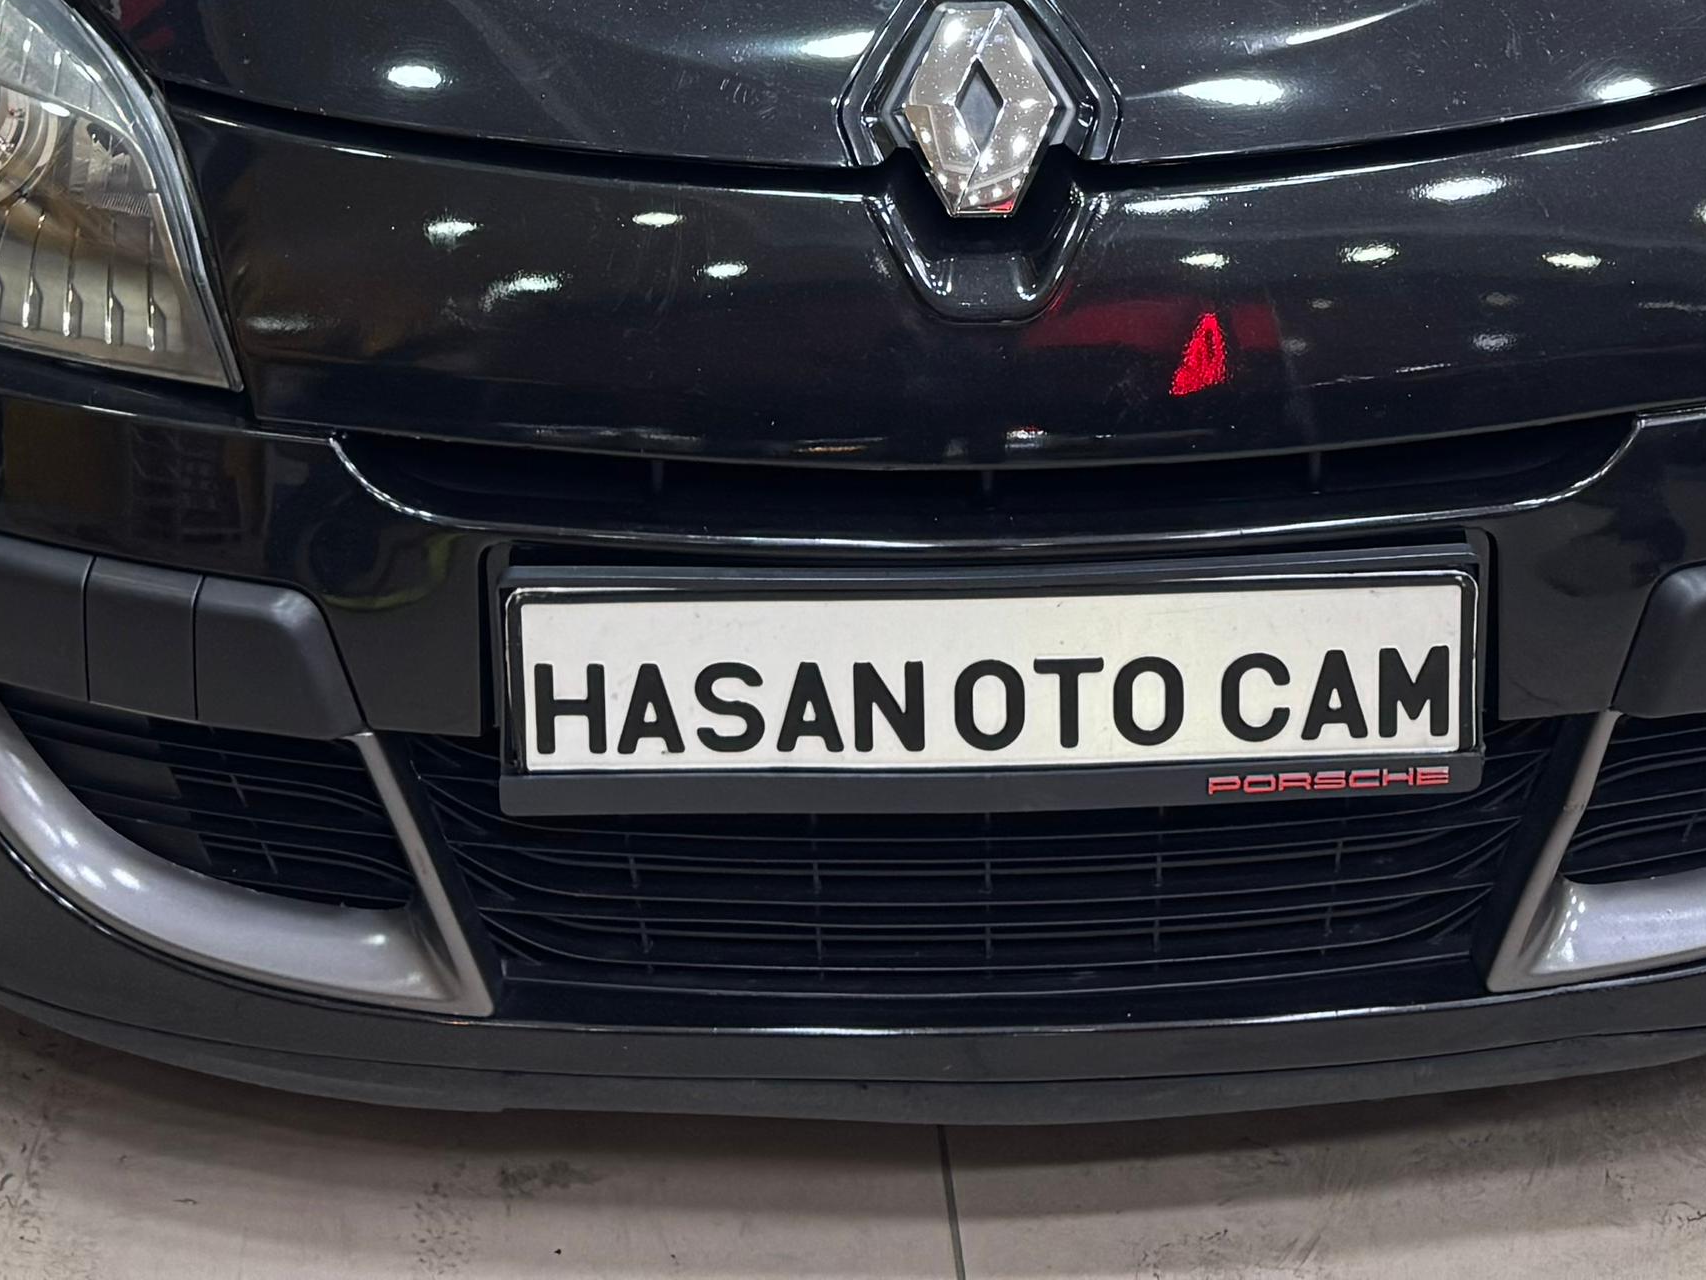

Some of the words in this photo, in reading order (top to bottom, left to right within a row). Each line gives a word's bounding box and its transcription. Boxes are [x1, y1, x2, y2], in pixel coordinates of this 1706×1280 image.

[534, 660, 927, 755] HASAN
[951, 655, 1185, 750] OTO
[1218, 643, 1451, 743] CAM
[1207, 766, 1450, 795] PORSCHE
